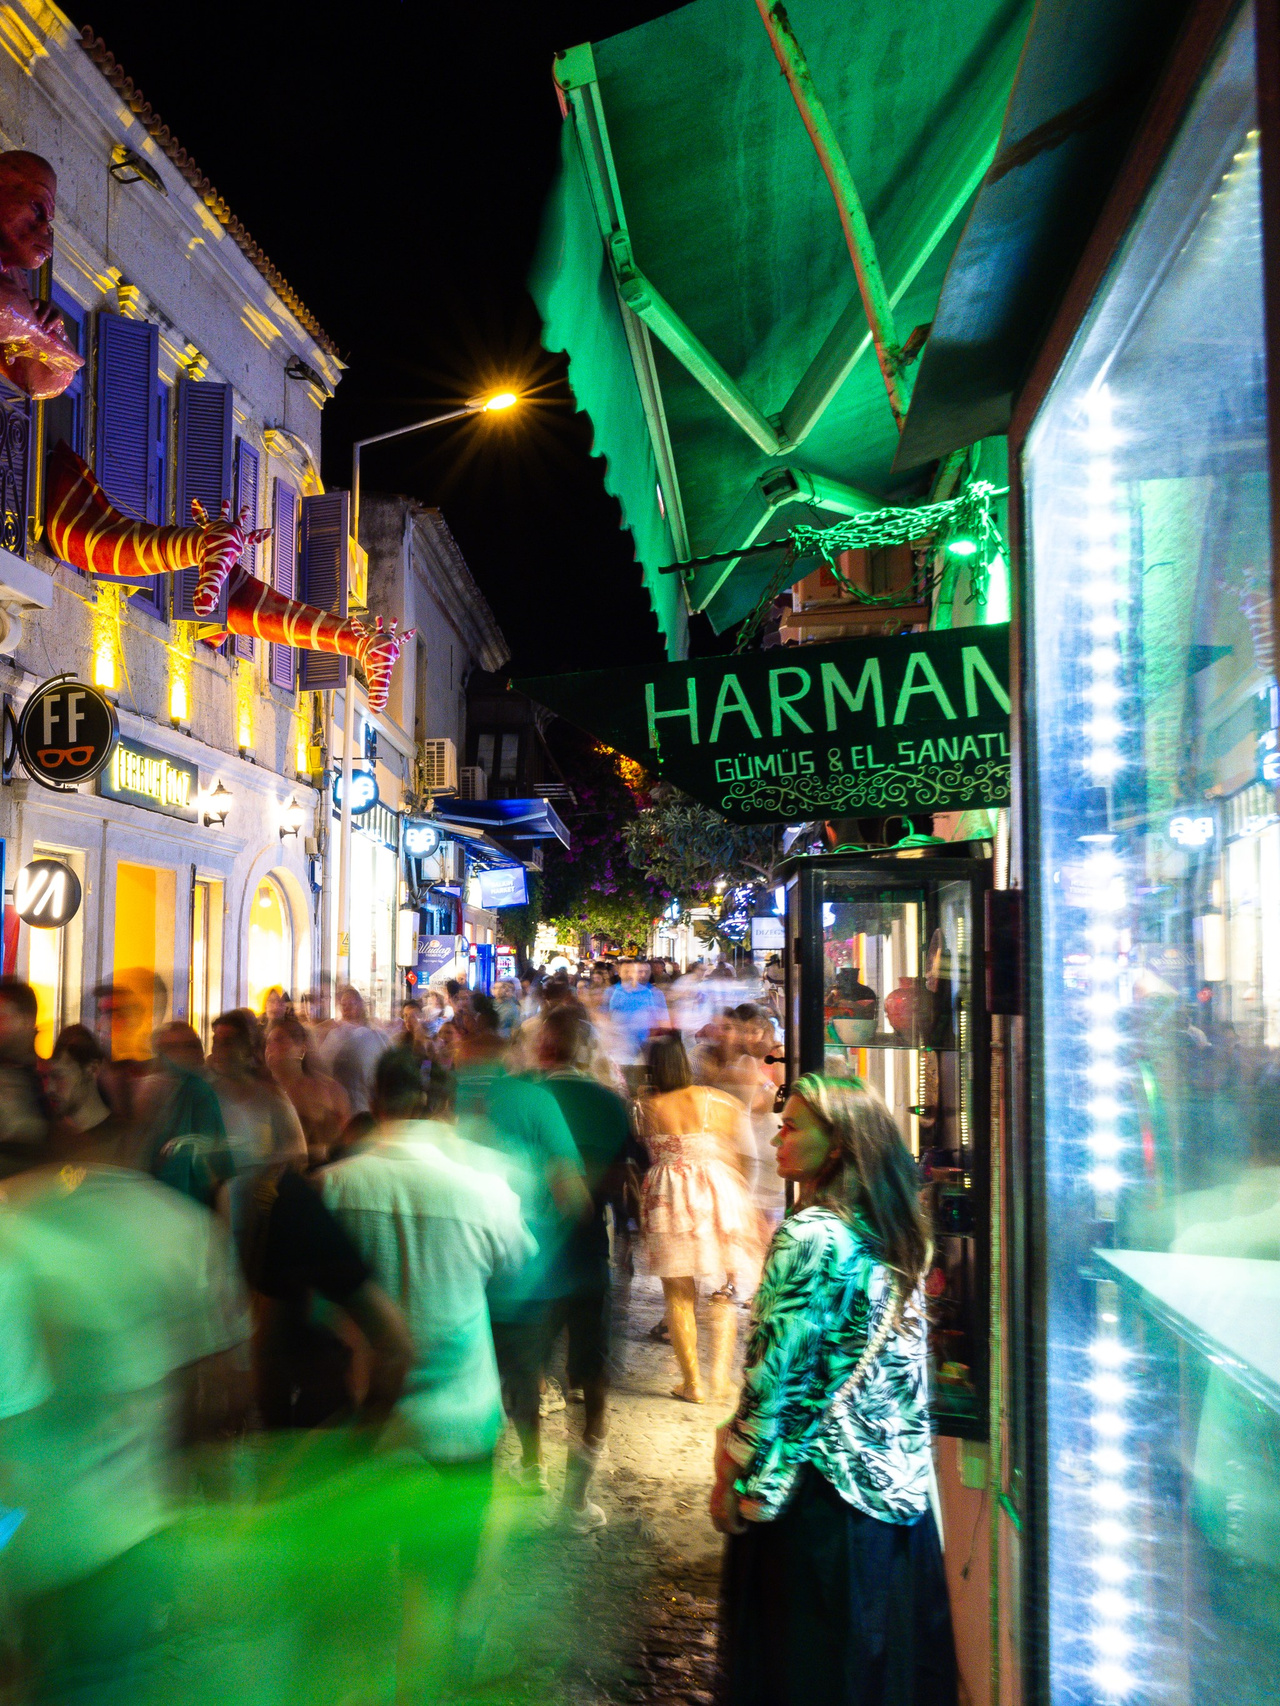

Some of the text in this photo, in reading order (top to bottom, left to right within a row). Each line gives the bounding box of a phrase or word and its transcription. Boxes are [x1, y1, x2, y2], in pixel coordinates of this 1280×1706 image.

[645, 646, 1011, 749] HARMAN
[827, 748, 844, 773] &
[851, 744, 886, 770] EL
